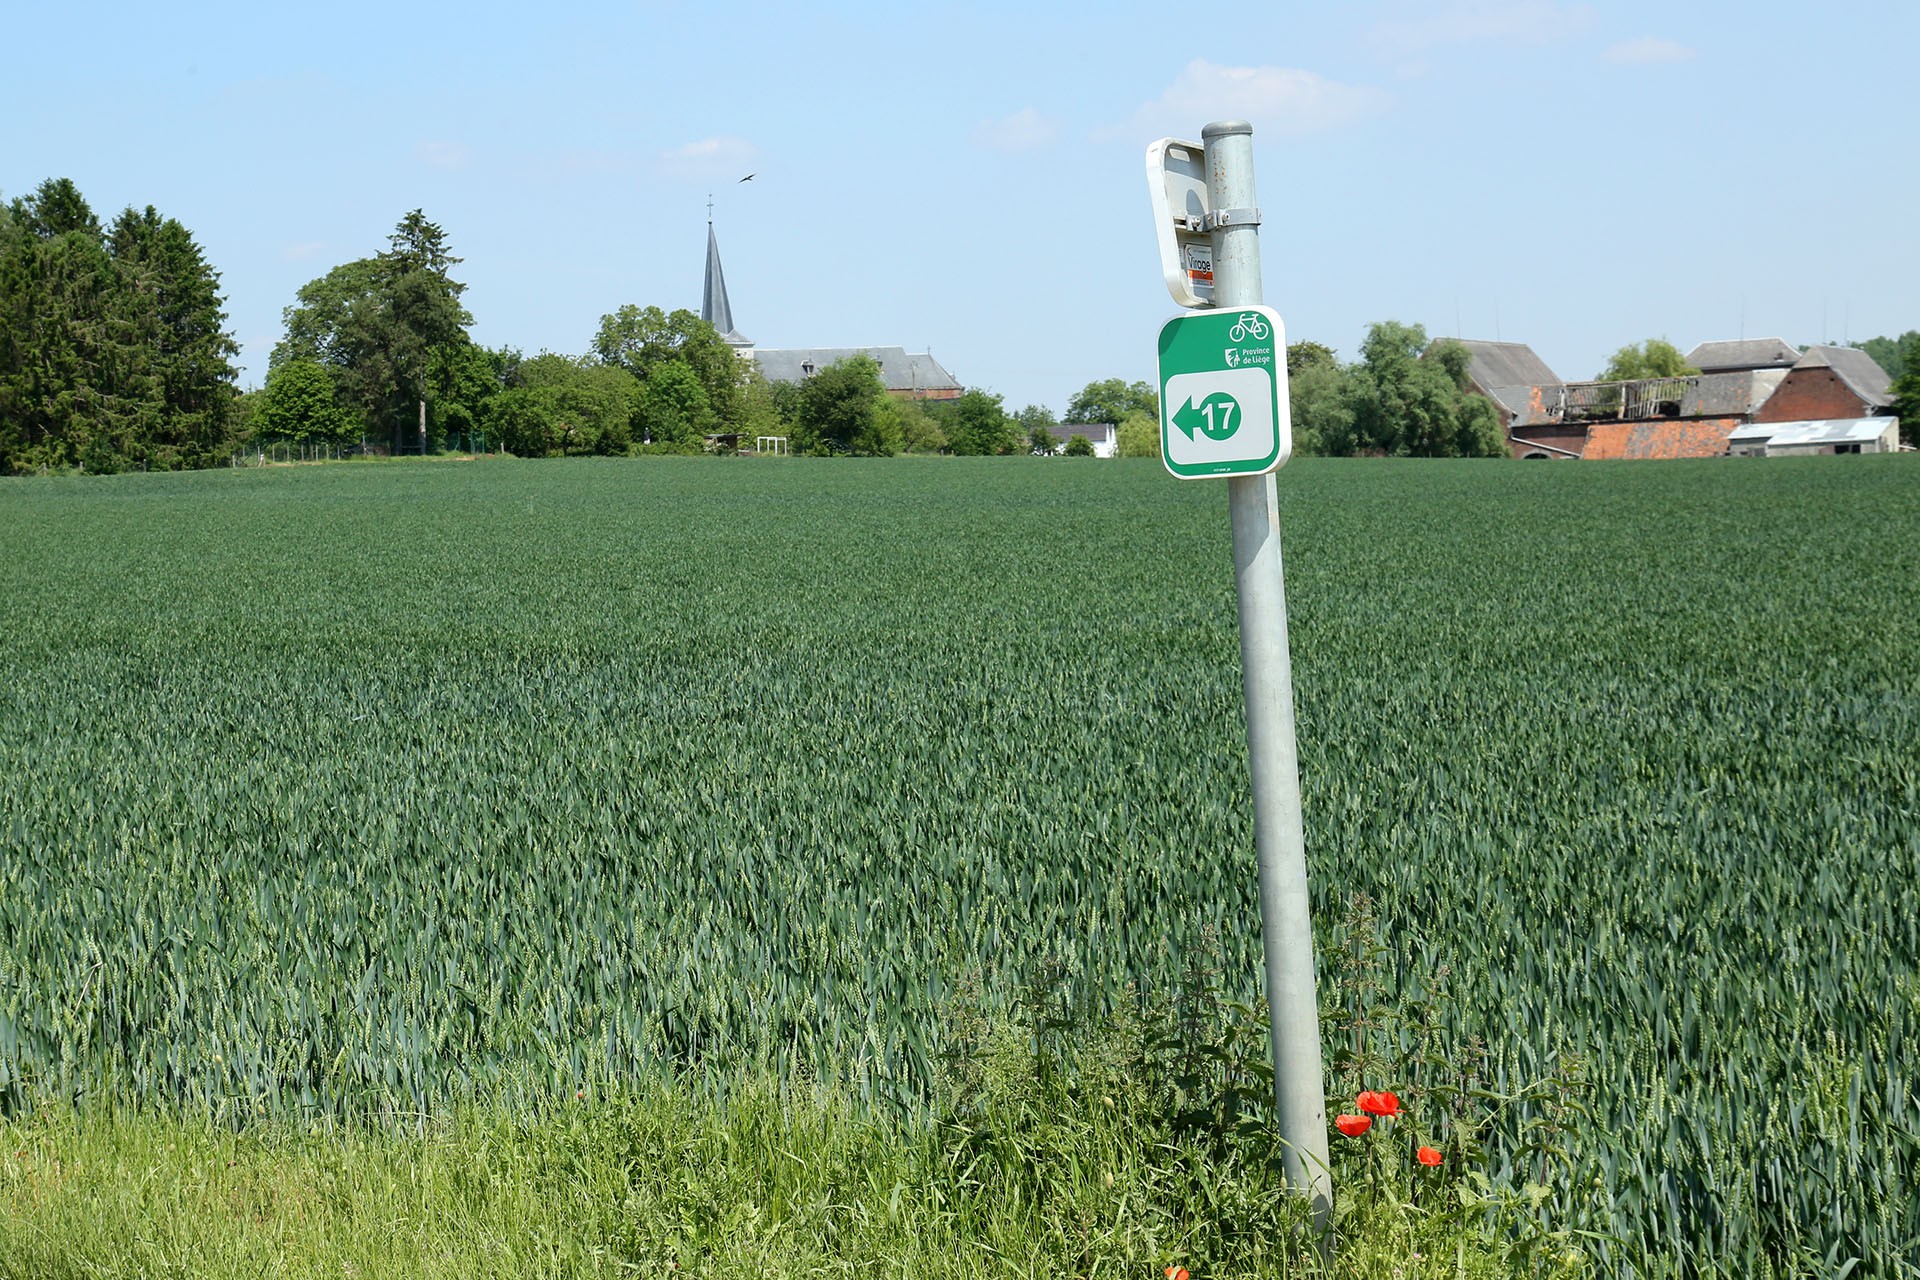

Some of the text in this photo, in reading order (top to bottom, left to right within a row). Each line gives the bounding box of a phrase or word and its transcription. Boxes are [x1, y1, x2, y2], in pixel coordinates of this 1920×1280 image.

[1187, 257, 1211, 273] Virage
[1242, 347, 1270, 356] Province
[1242, 355, 1271, 366] de Liège
[1201, 402, 1235, 431] 17
